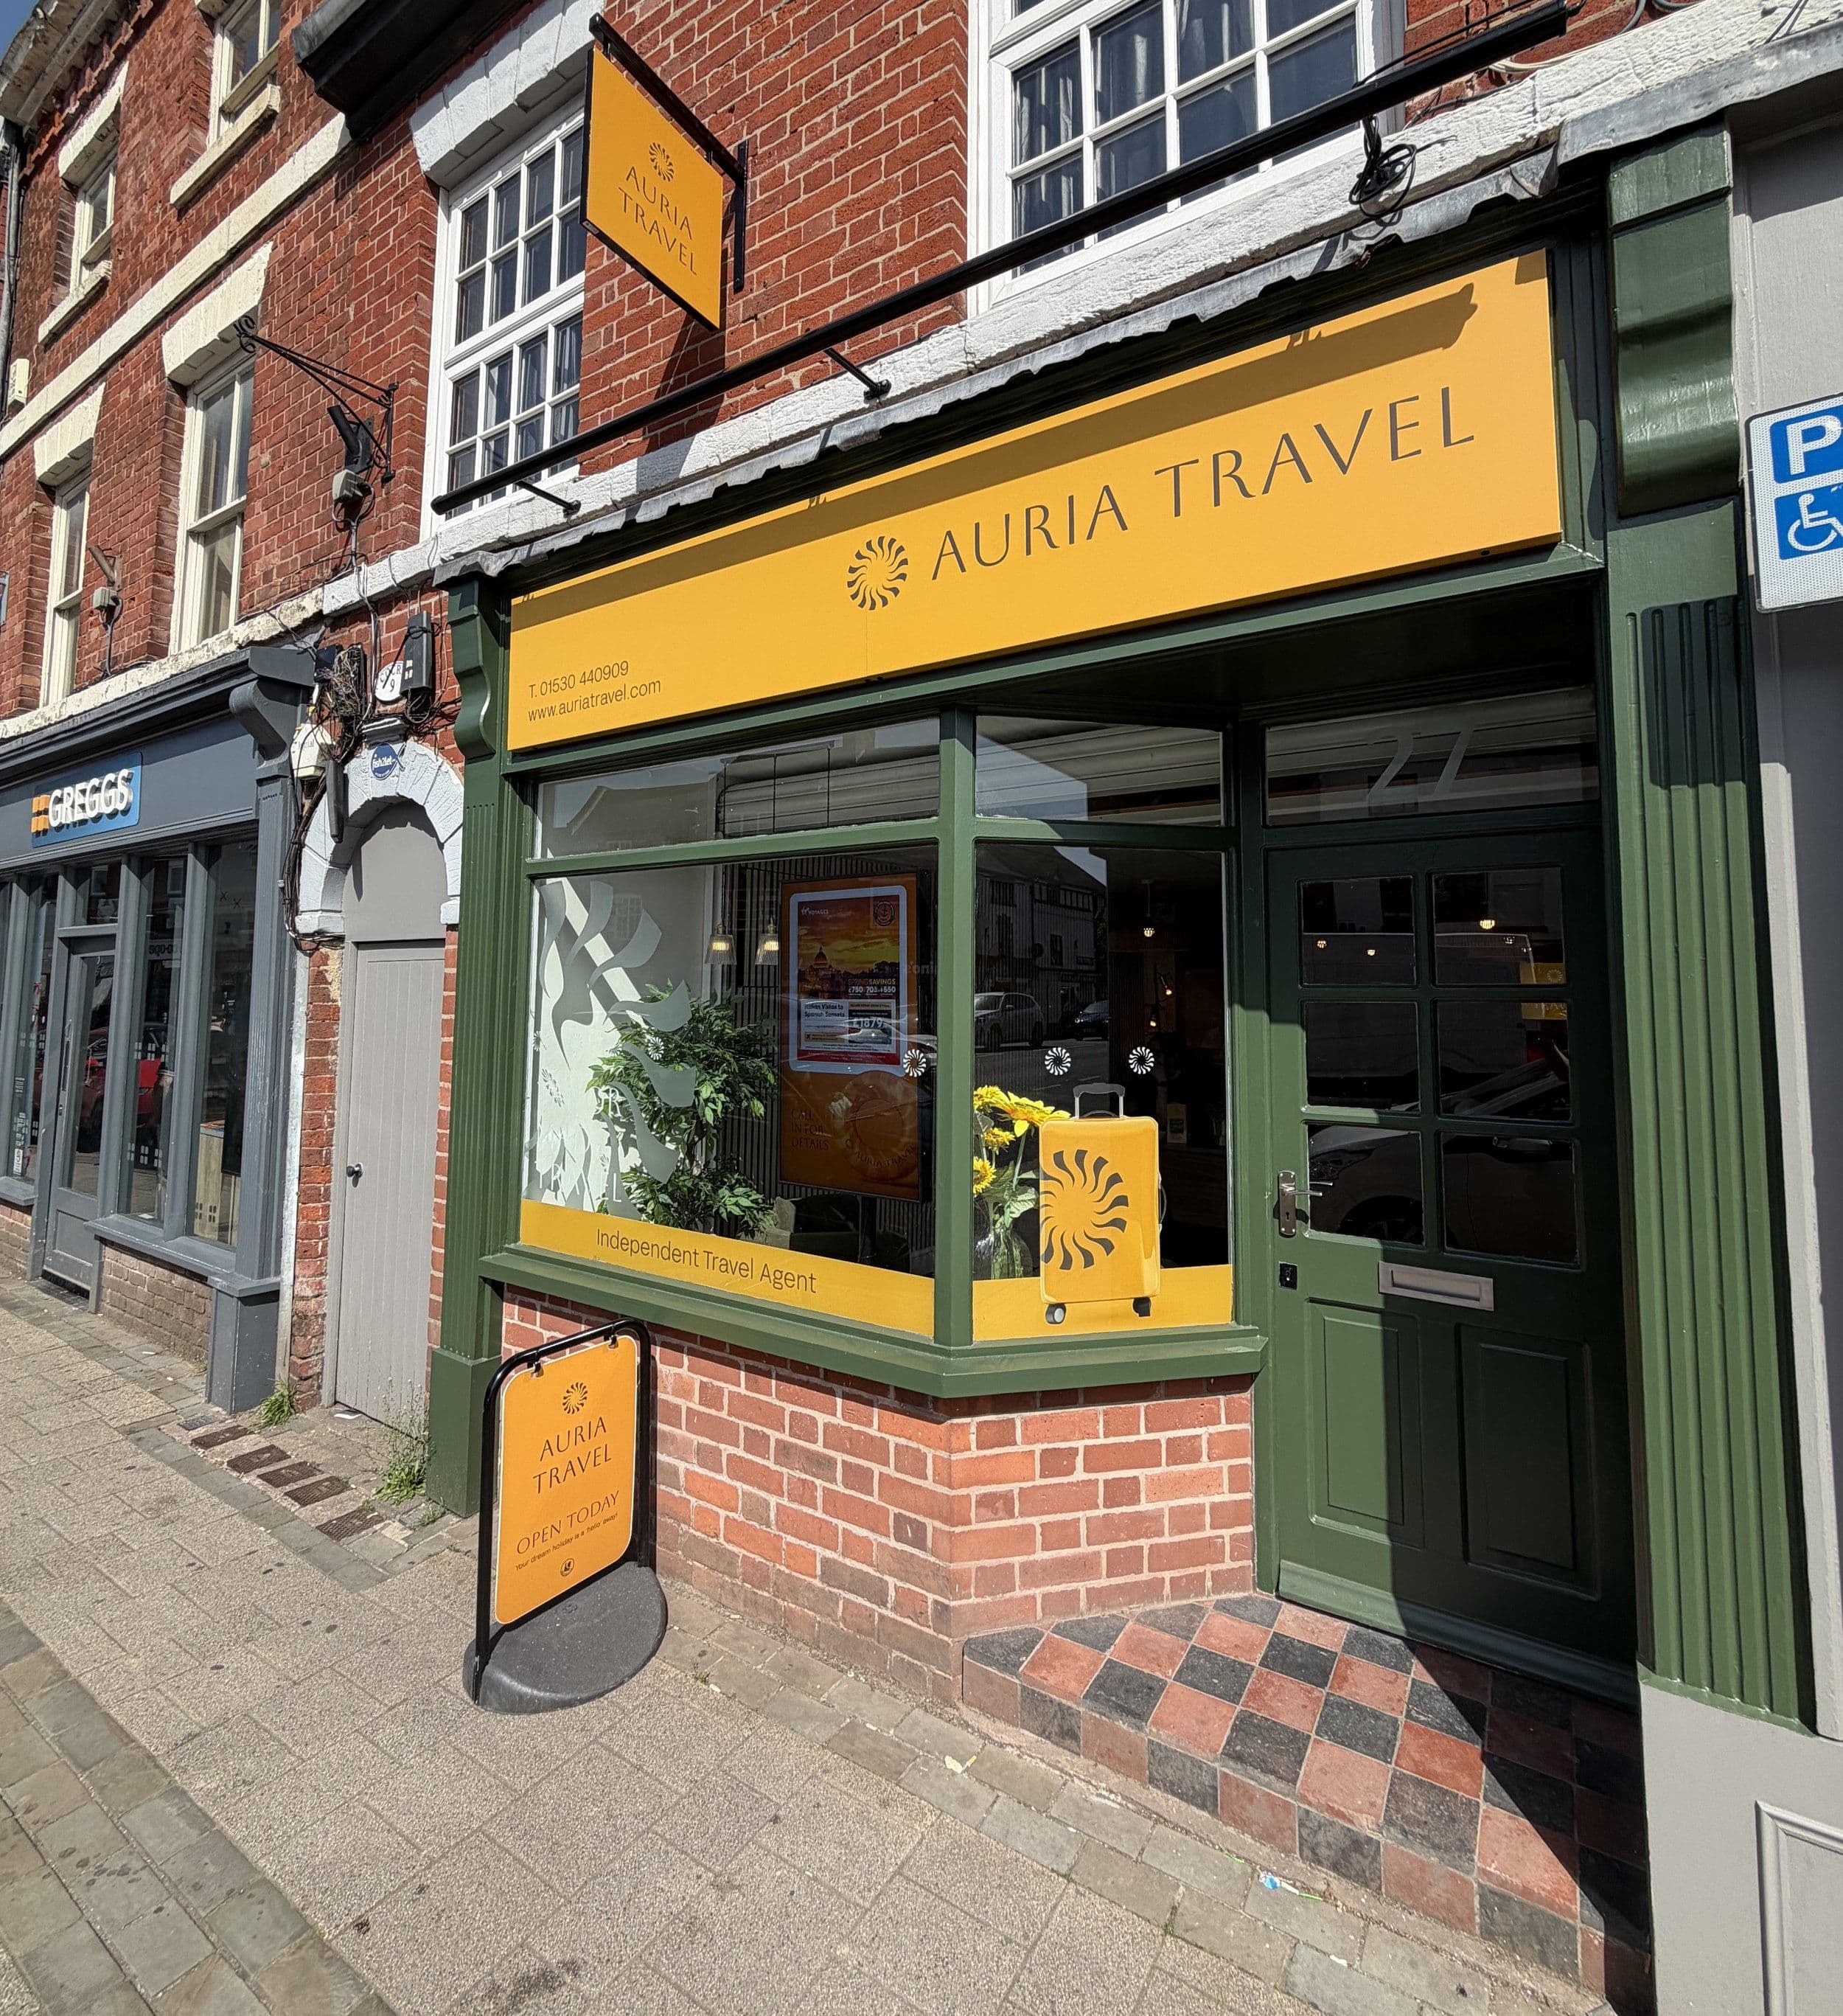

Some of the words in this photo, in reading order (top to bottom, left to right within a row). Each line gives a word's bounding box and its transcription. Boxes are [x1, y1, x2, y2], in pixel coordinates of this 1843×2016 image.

[618, 187, 697, 276] TRAVEL
[626, 166, 692, 241] AURIA
[1785, 414, 1842, 476] P
[931, 484, 1129, 581] AURIA
[1154, 386, 1475, 518] TRAVEL
[528, 680, 661, 722] www.auriatravel.com
[529, 684, 537, 698] T.
[540, 674, 576, 696] 01530
[579, 661, 629, 686] 440909
[1366, 720, 1474, 804] 27
[49, 768, 133, 827] GREGGS
[791, 1139, 829, 1150] DETAILS
[596, 1228, 700, 1268] Independent
[703, 1250, 753, 1279] Travel
[759, 1262, 817, 1294] Agent
[532, 1443, 612, 1494] TRAVEL
[539, 1416, 607, 1461] AURIA
[516, 1520, 562, 1554] OPEN
[567, 1490, 619, 1529] TODAY
[531, 1548, 551, 1563] dream
[552, 1536, 574, 1552] holiday
